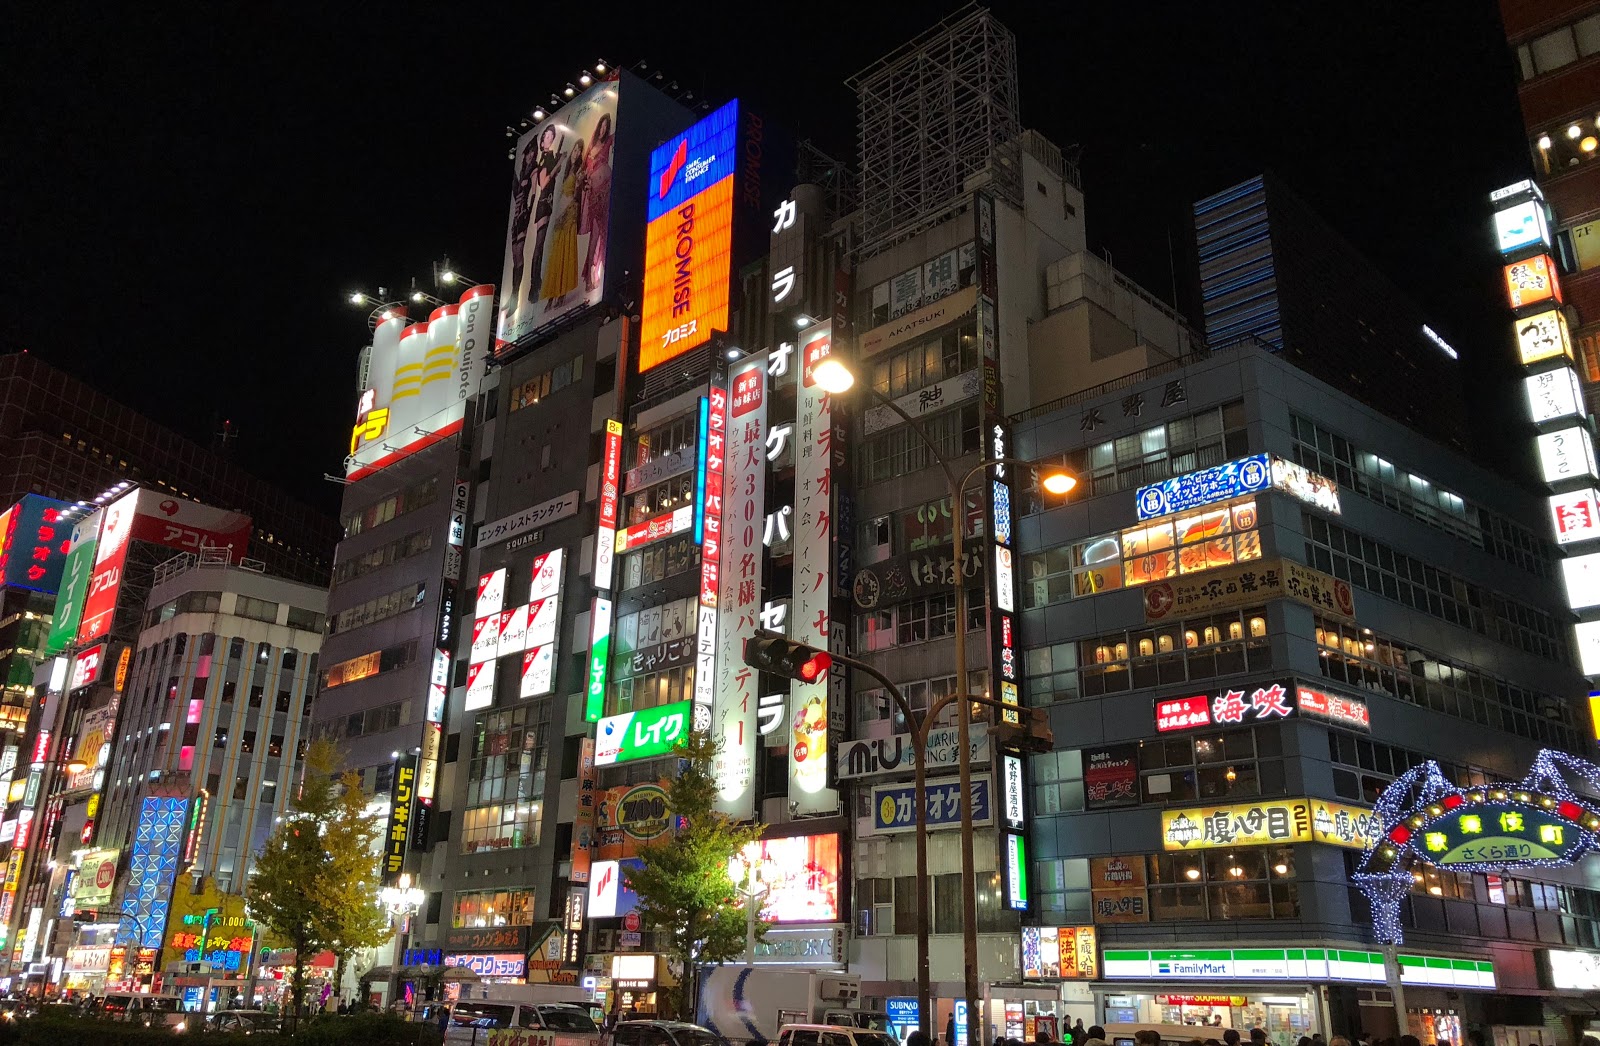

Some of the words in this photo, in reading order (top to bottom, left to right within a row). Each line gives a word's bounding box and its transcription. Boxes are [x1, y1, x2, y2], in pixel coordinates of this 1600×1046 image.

[1576, 225, 1593, 238] 7F
[672, 203, 696, 319] PROMISE
[466, 299, 480, 334] Don
[888, 308, 945, 339] AKATSUKI
[661, 319, 697, 349] プロミス
[458, 337, 477, 399] Quijote
[737, 376, 758, 394] 新宿
[1080, 380, 1188, 432] 水野屋
[609, 421, 620, 433] 8F
[707, 393, 725, 469] カラオケ
[1166, 476, 1237, 502] ドイツビアホール
[703, 494, 720, 556] パセラ
[506, 531, 539, 551] SQUARE
[59, 552, 82, 630] レイク
[91, 565, 120, 598] アコム
[502, 613, 511, 624] 5F
[524, 651, 535, 663] 2F
[632, 642, 680, 673] きゃりこ
[700, 611, 714, 682] パーティー
[590, 656, 604, 696] レイク
[1212, 683, 1294, 723] 海峡
[1327, 697, 1369, 726] 海峡
[633, 712, 684, 748] レイク
[580, 778, 593, 808] 麻雀
[1008, 759, 1019, 818] 水野屋酒店
[1088, 779, 1137, 801] 海峡
[621, 796, 666, 823] ZOO
[1202, 804, 1291, 845] 腹八分目
[1293, 804, 1308, 837] 2F
[1425, 811, 1564, 853] 歌舞伎町
[1461, 842, 1532, 861] さくら通り
[1097, 896, 1144, 916] 腹八分目
[456, 955, 524, 976] ダイコクドラッグ
[1061, 939, 1075, 970] 海峡
[1173, 963, 1227, 975] FamilyMart
